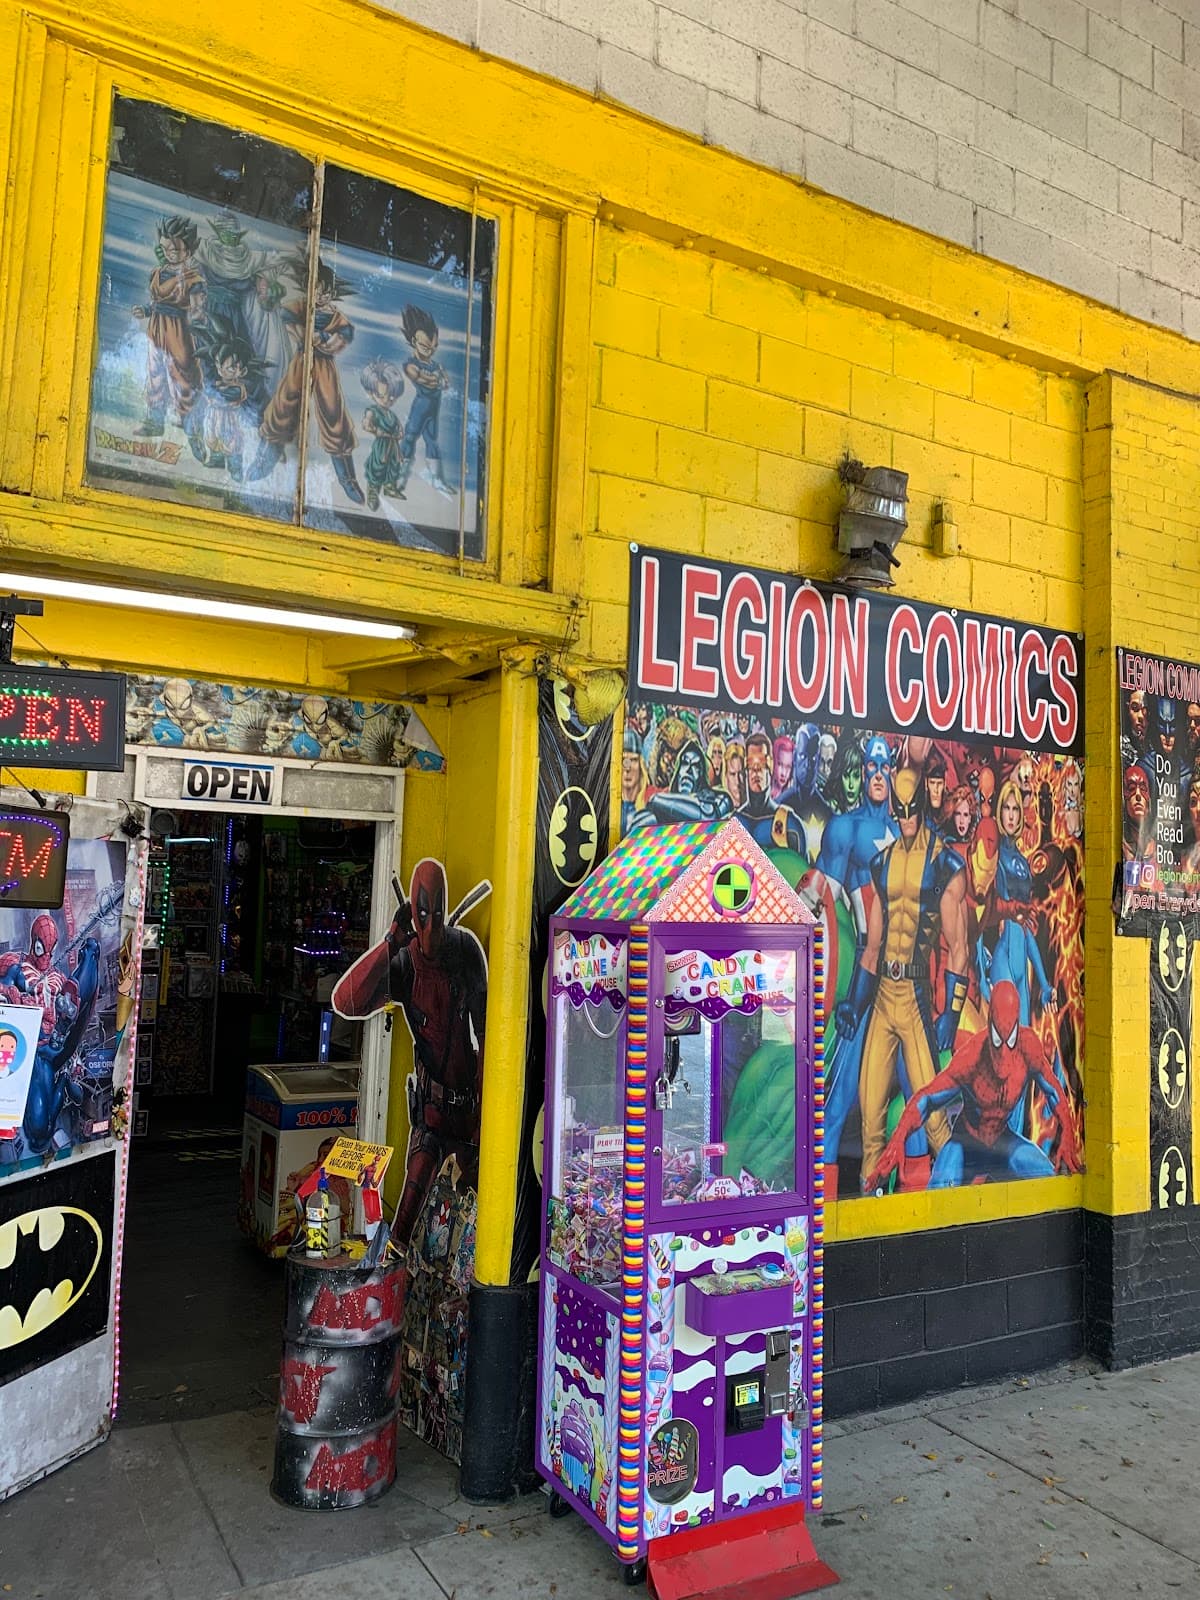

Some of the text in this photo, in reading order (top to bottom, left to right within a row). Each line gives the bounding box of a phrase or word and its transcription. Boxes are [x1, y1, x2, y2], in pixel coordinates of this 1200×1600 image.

[637, 556, 1079, 748] LEGION COMICS
[1119, 653, 1200, 703] LEGION COMI
[1156, 754, 1172, 774] Do
[187, 765, 271, 802] OPEN
[1156, 776, 1177, 799] You
[1156, 799, 1182, 822] Even
[1156, 822, 1184, 844] Read
[1156, 844, 1181, 866] Bro..
[1126, 889, 1156, 913] Open
[564, 938, 597, 960] CANDY
[573, 958, 608, 979] CRANE
[687, 955, 749, 981] CANDY
[706, 972, 768, 998] CRANE
[296, 1107, 347, 1126] 100%
[328, 1158, 357, 1171] WALKING
[340, 1149, 366, 1162] BEFORE
[647, 1464, 689, 1489] PRIZE
